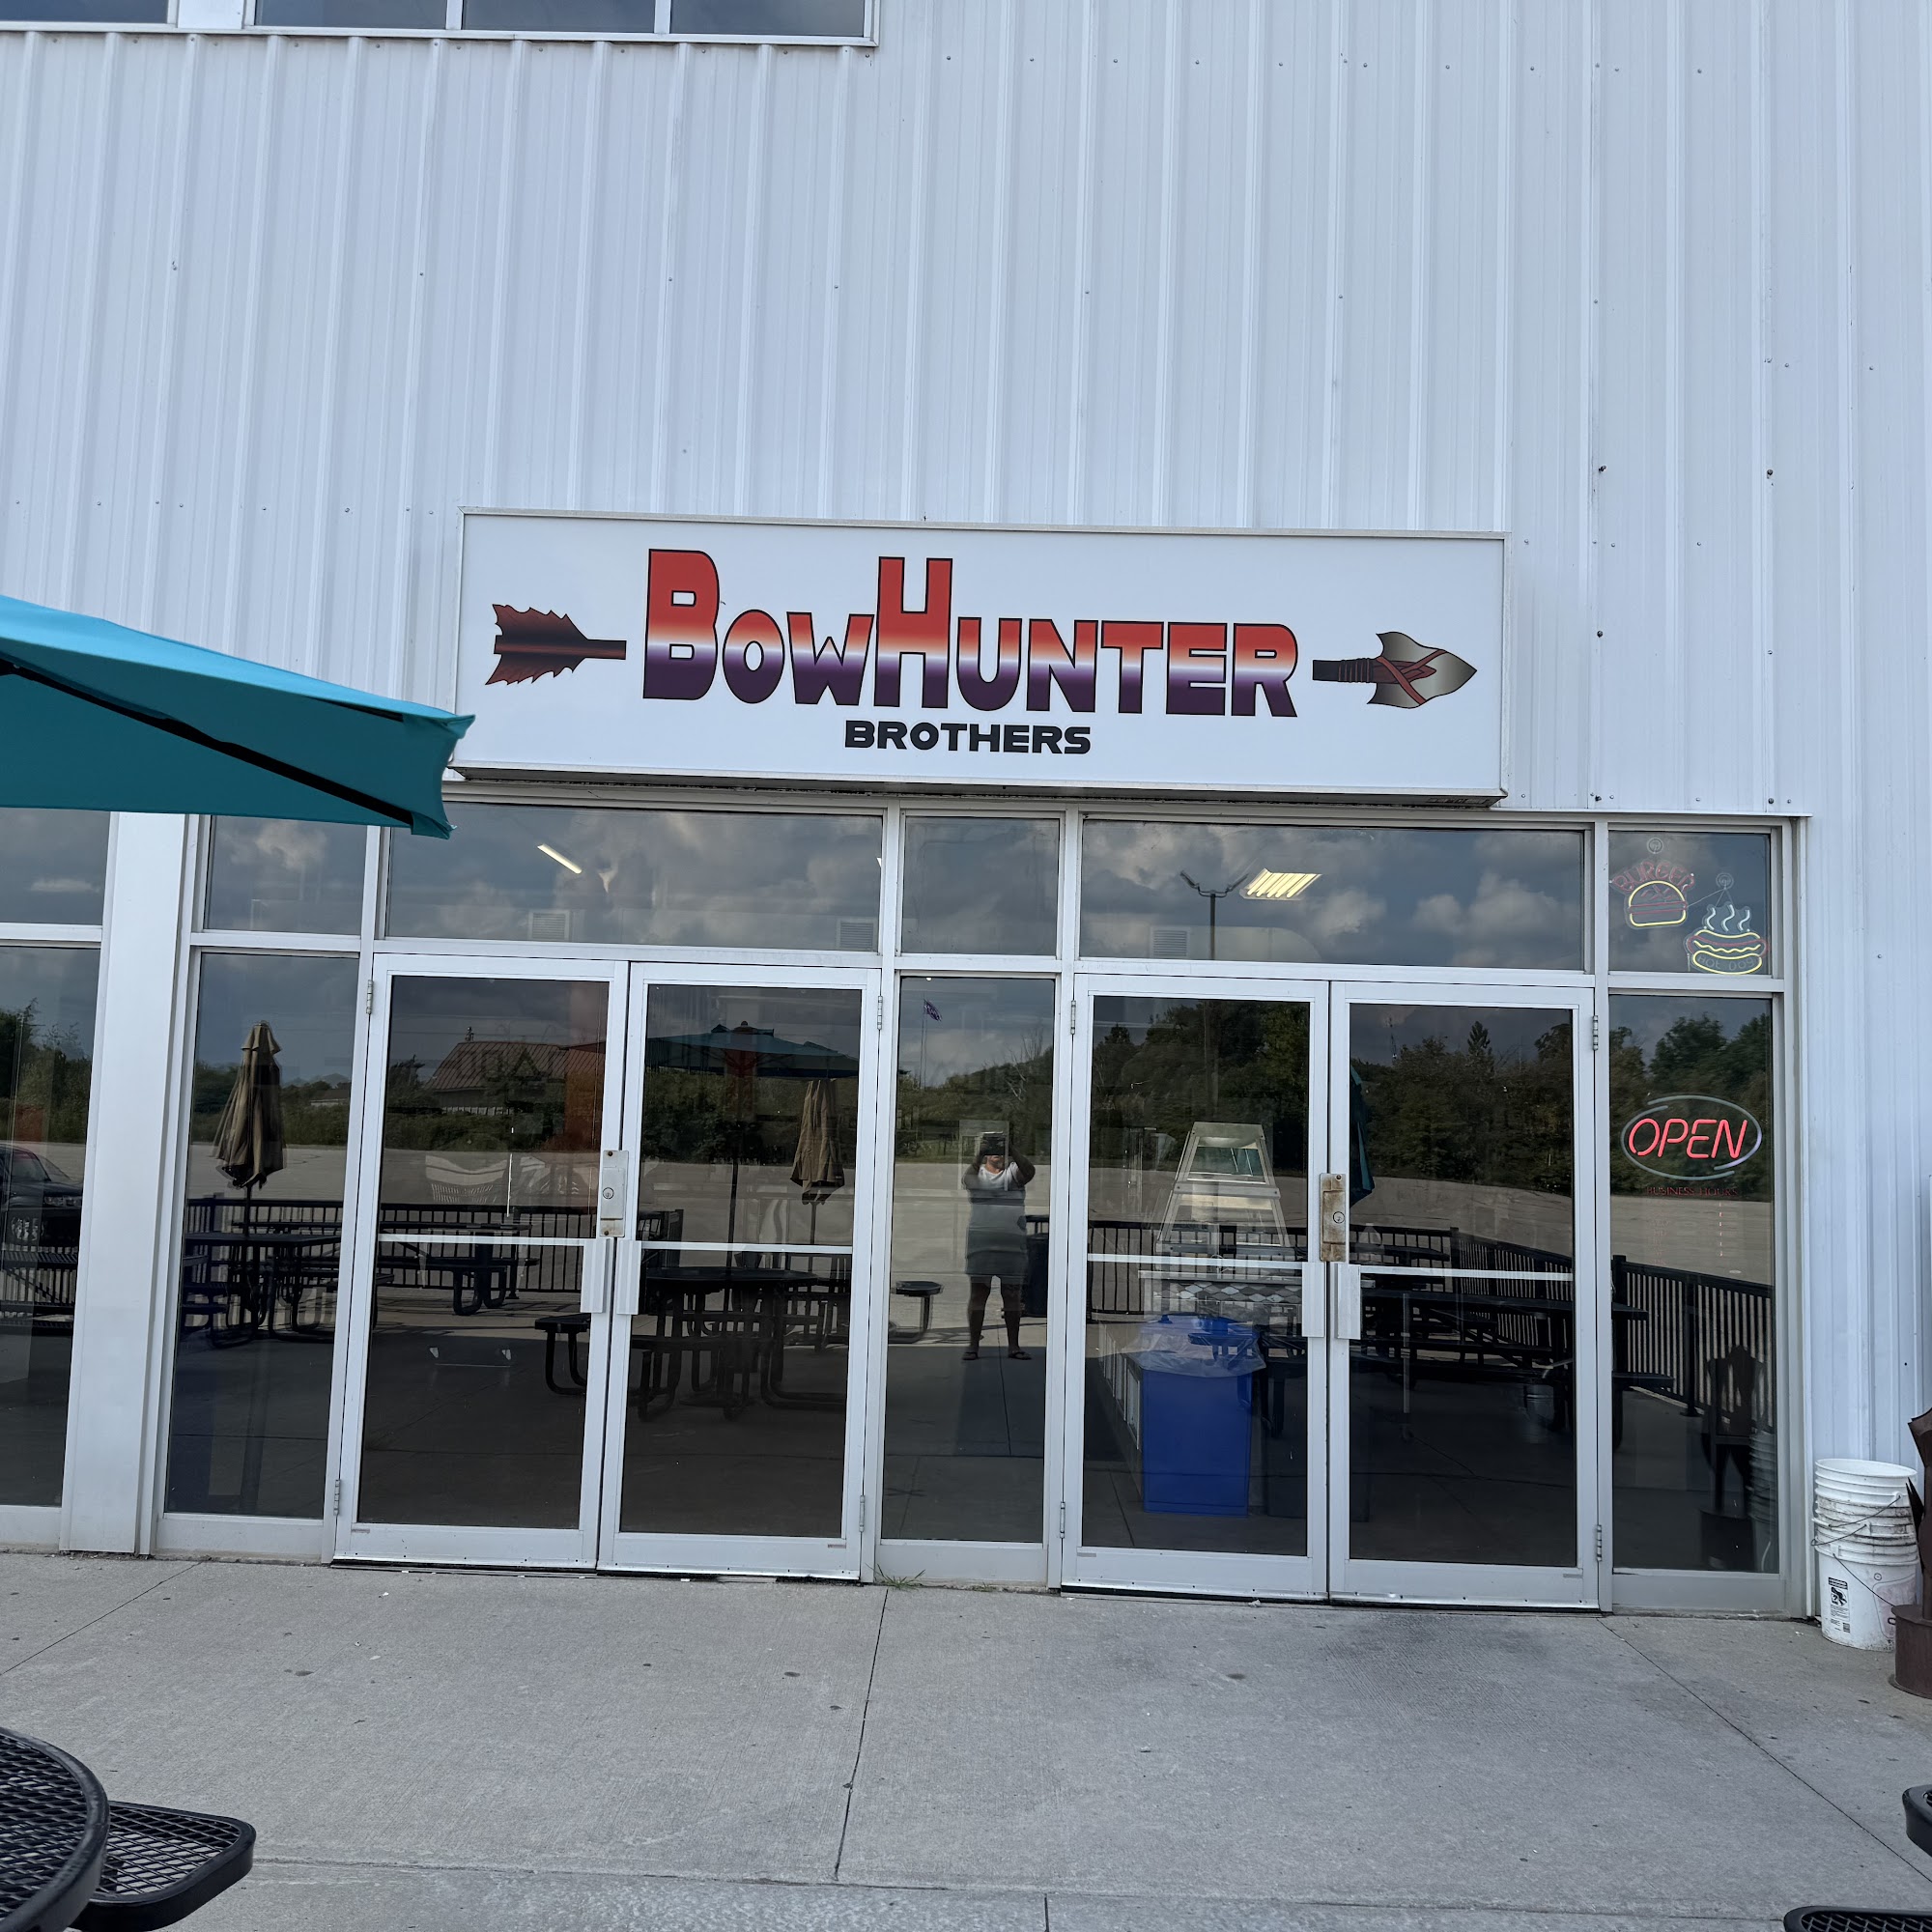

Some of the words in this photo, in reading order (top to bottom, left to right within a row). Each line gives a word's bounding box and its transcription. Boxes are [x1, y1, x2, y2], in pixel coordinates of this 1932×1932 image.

[845, 720, 1091, 753] BROTHERS
[1611, 861, 1695, 893] BURGER
[1629, 1118, 1747, 1158] OPEN
[1646, 1186, 1694, 1197] BUSINESS
[1699, 1187, 1738, 1198] HOURS
